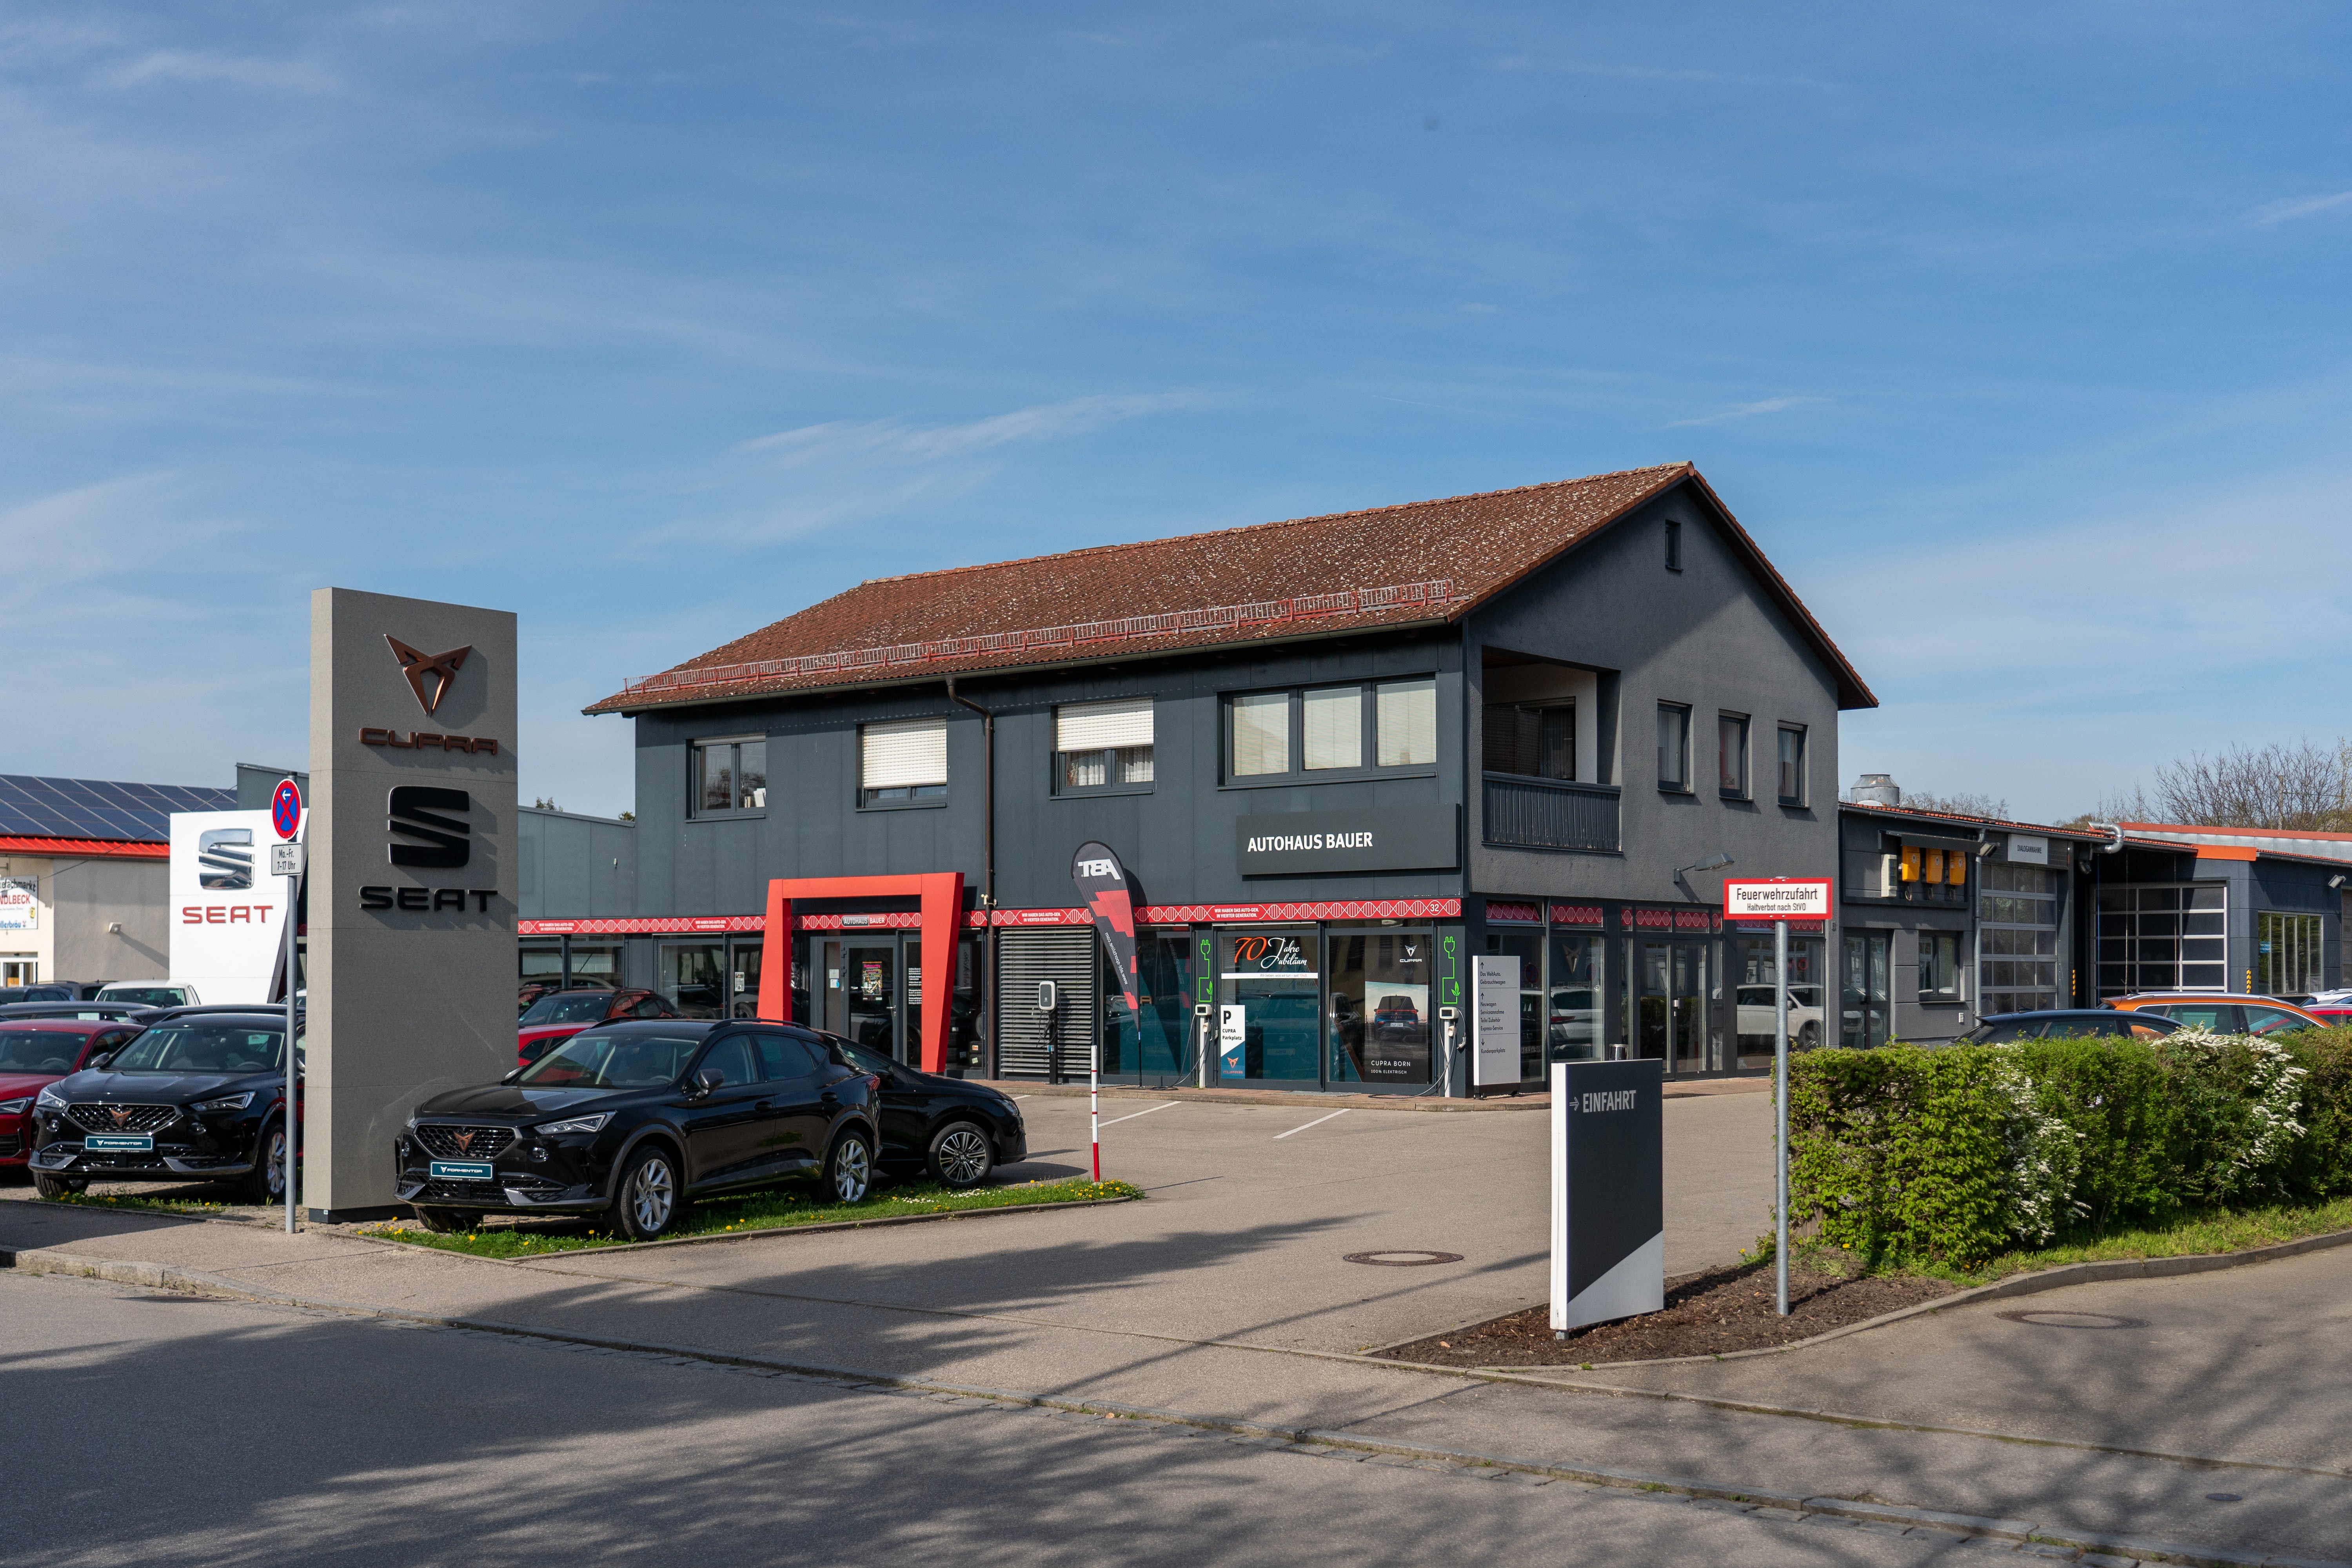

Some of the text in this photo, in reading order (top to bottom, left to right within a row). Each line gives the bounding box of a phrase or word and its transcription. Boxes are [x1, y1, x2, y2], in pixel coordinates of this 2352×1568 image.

[360, 727, 498, 755] CUPRA
[1247, 832, 1373, 852] AUTOHAUS BAUER
[279, 849, 294, 858] Mo.-Fr.
[2017, 845, 2042, 854] DIALOGANNAHME
[278, 861, 287, 870] 7-17
[0, 878, 36, 892] efachmarkt
[360, 886, 498, 912] SEAT
[1737, 888, 1817, 900] Feuerwehrzufahrt
[182, 905, 273, 924] SEAT
[1430, 903, 1439, 912] 32
[1234, 937, 1267, 963] 70
[1224, 1010, 1231, 1024] P
[1583, 1090, 1636, 1113] EINFAHRT
